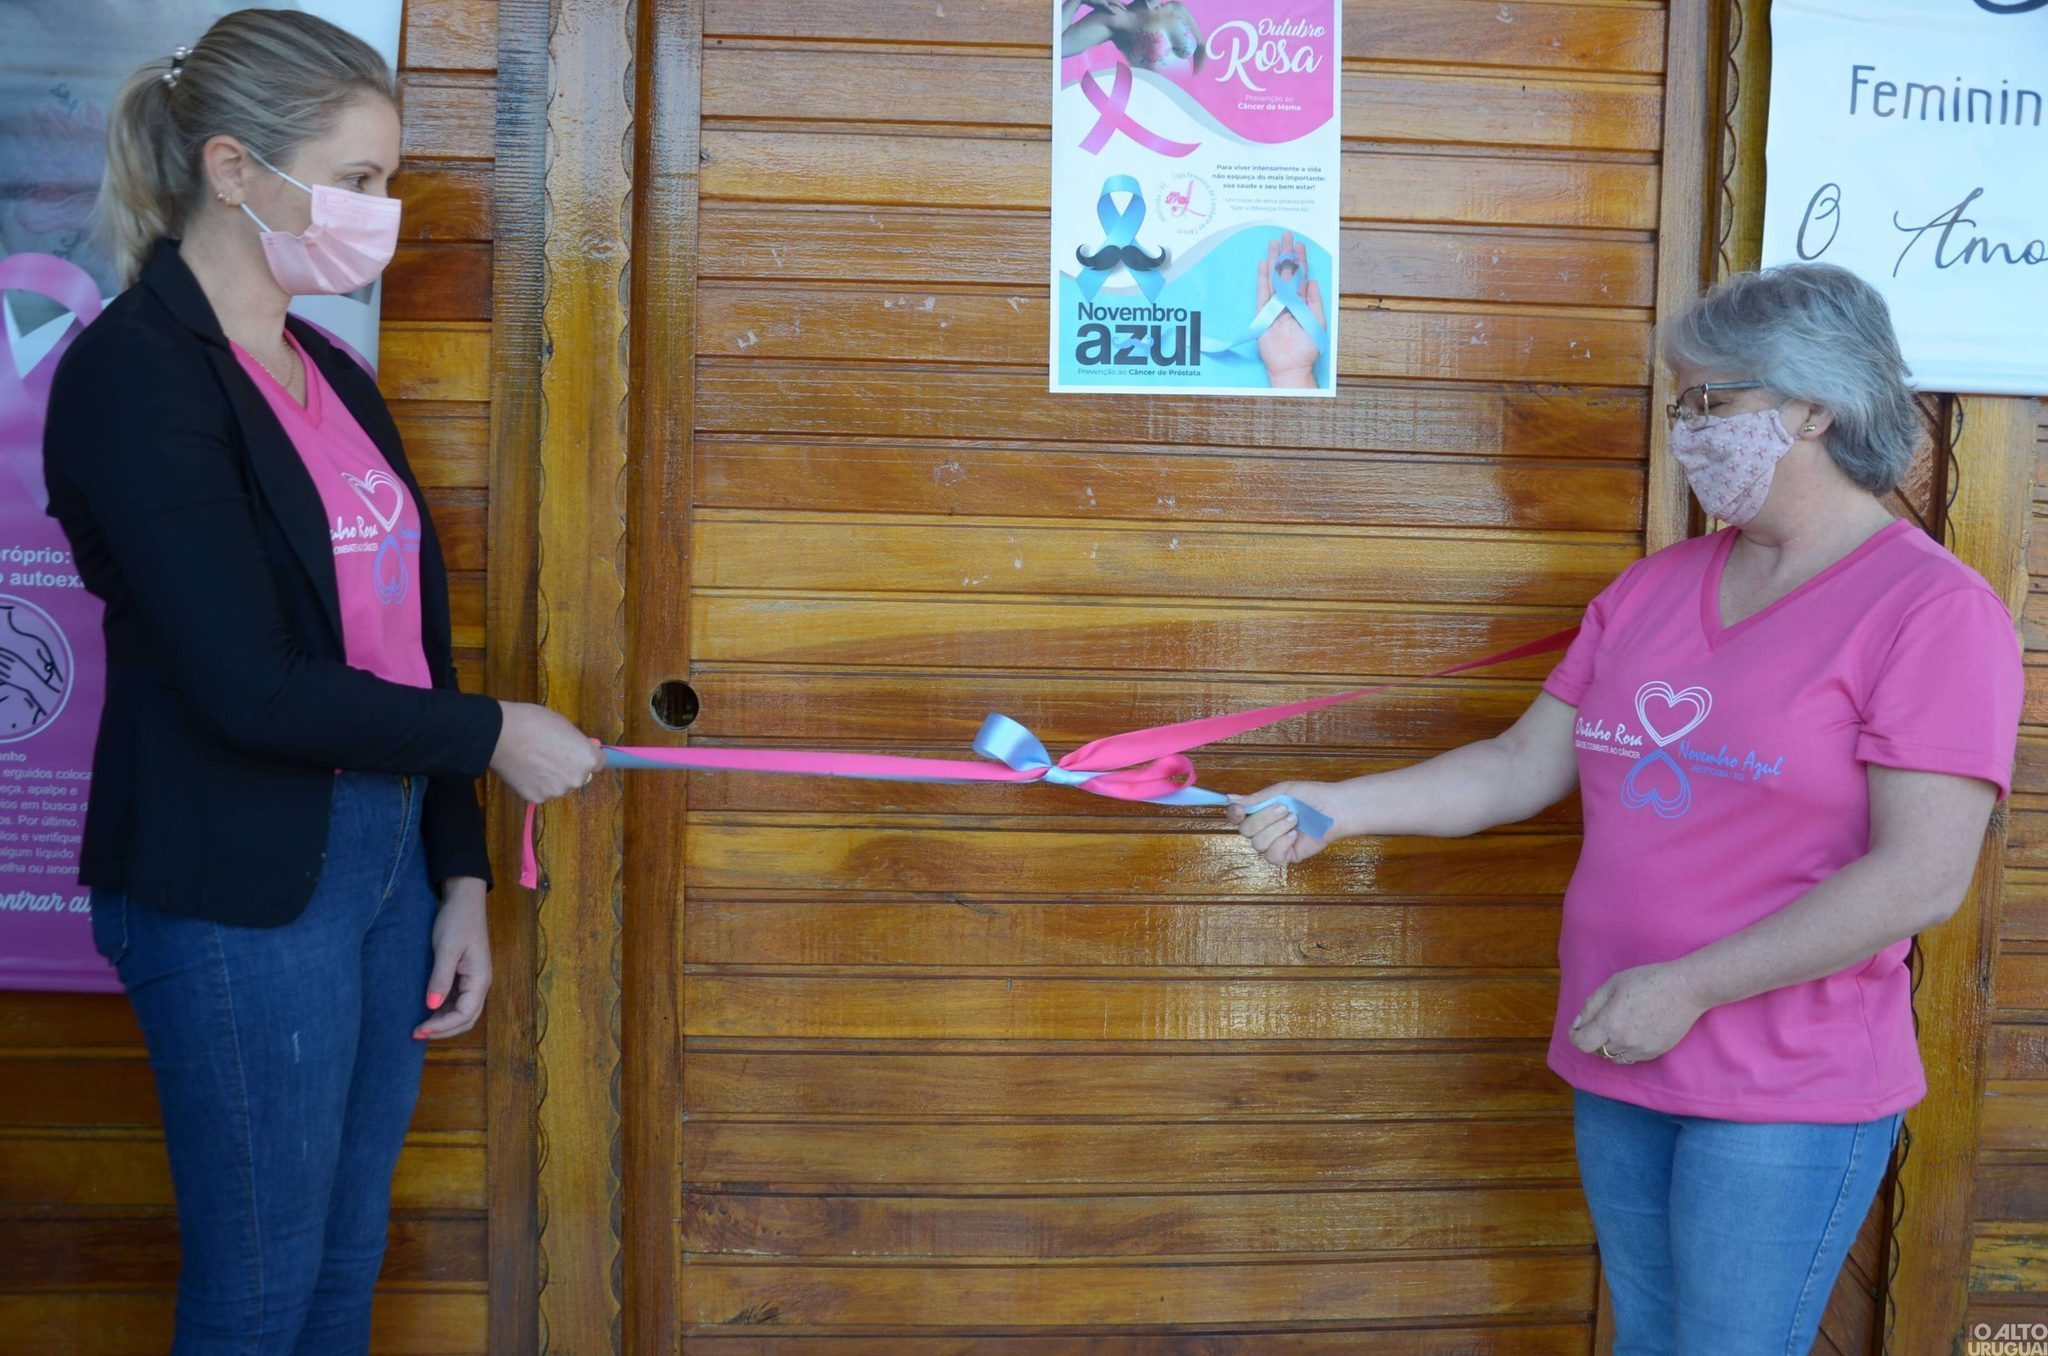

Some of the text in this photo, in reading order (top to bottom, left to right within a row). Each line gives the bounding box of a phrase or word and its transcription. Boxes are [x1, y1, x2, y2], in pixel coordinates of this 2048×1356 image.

[1258, 17, 1326, 37] Outubro
[1205, 20, 1323, 92] Rosa
[1849, 64, 2042, 126] Feminin
[1237, 102, 1264, 110] Câncer
[1078, 302, 1188, 322] Novembro
[1075, 310, 1202, 366] azul
[1078, 368, 1116, 376] Prevenção
[1128, 368, 1155, 376] Câncer
[1169, 369, 1201, 377] Próstata
[0, 545, 70, 566] róprio:
[1614, 723, 1643, 746] Rosa
[1742, 750, 1784, 781] Azul
[2, 768, 53, 780] erguidos
[28, 786, 67, 796] apalpe
[70, 787, 78, 795] e
[21, 801, 39, 810] em
[42, 801, 77, 812] busca
[18, 814, 39, 825] Por
[21, 833, 29, 842] e
[32, 832, 81, 845] verifique
[28, 865, 44, 874] ou
